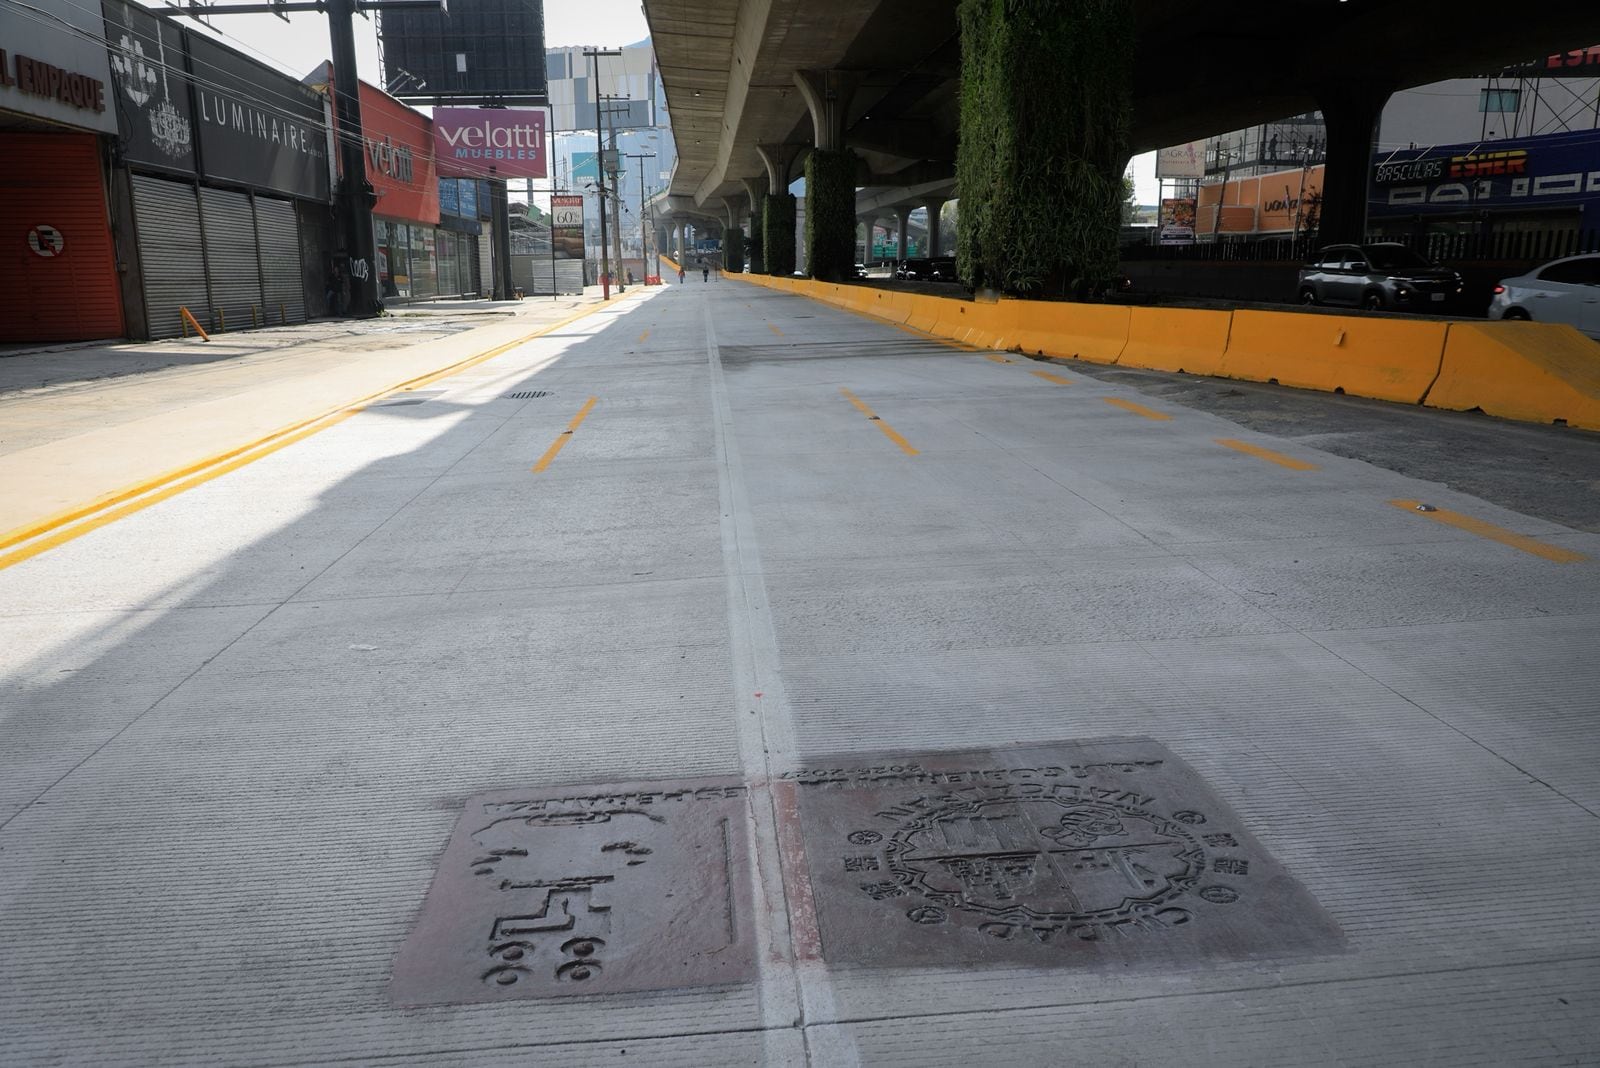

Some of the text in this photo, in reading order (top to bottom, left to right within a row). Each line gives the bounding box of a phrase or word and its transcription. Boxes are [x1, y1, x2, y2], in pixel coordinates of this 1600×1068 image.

[15, 54, 106, 113] EMPAQUE
[201, 91, 307, 153] LUMINAIRE
[438, 120, 540, 148] velatti
[455, 148, 536, 160] MUEBLES
[1375, 150, 1528, 183] BASCULAS ESHER
[977, 906, 1196, 941] CIUDAD
